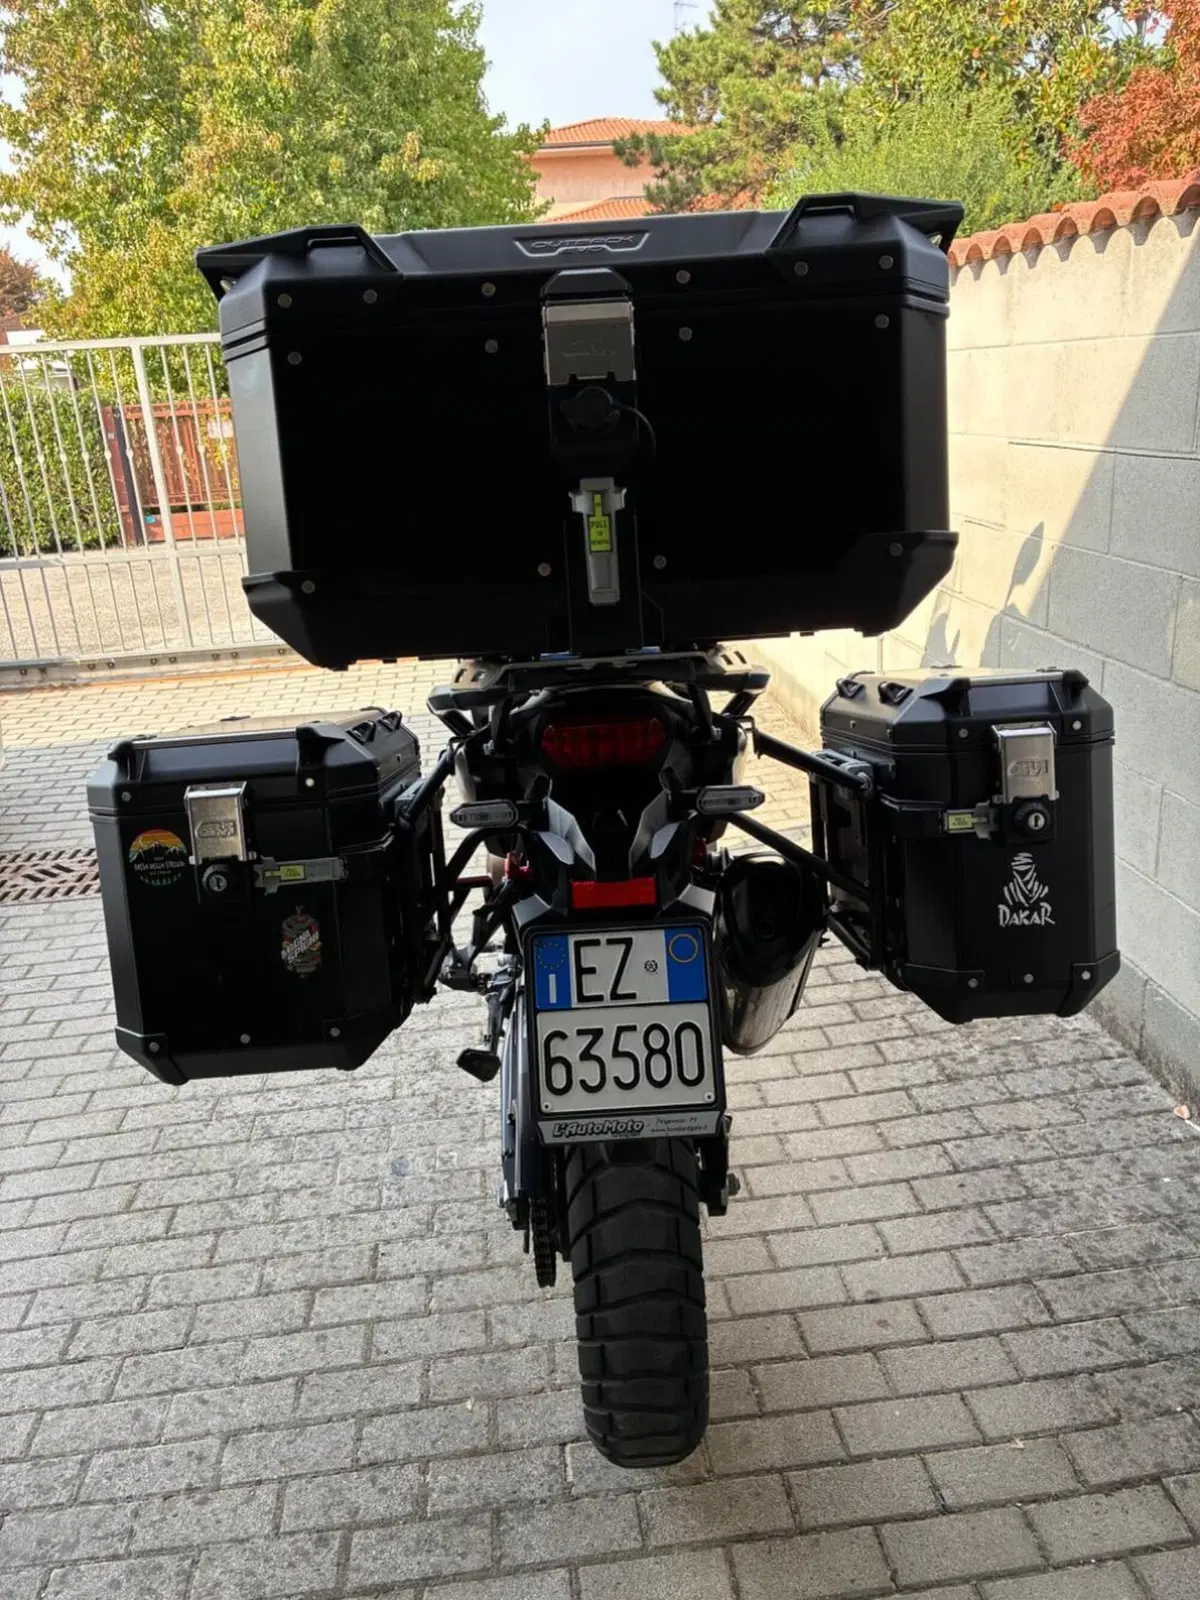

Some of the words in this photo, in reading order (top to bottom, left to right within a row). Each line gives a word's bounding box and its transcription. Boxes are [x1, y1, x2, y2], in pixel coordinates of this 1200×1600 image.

[998, 902, 1056, 928] DAKAR
[573, 937, 637, 1003] EZ
[543, 1021, 705, 1096] 63580
[552, 1119, 644, 1139] L'AutoMoto
